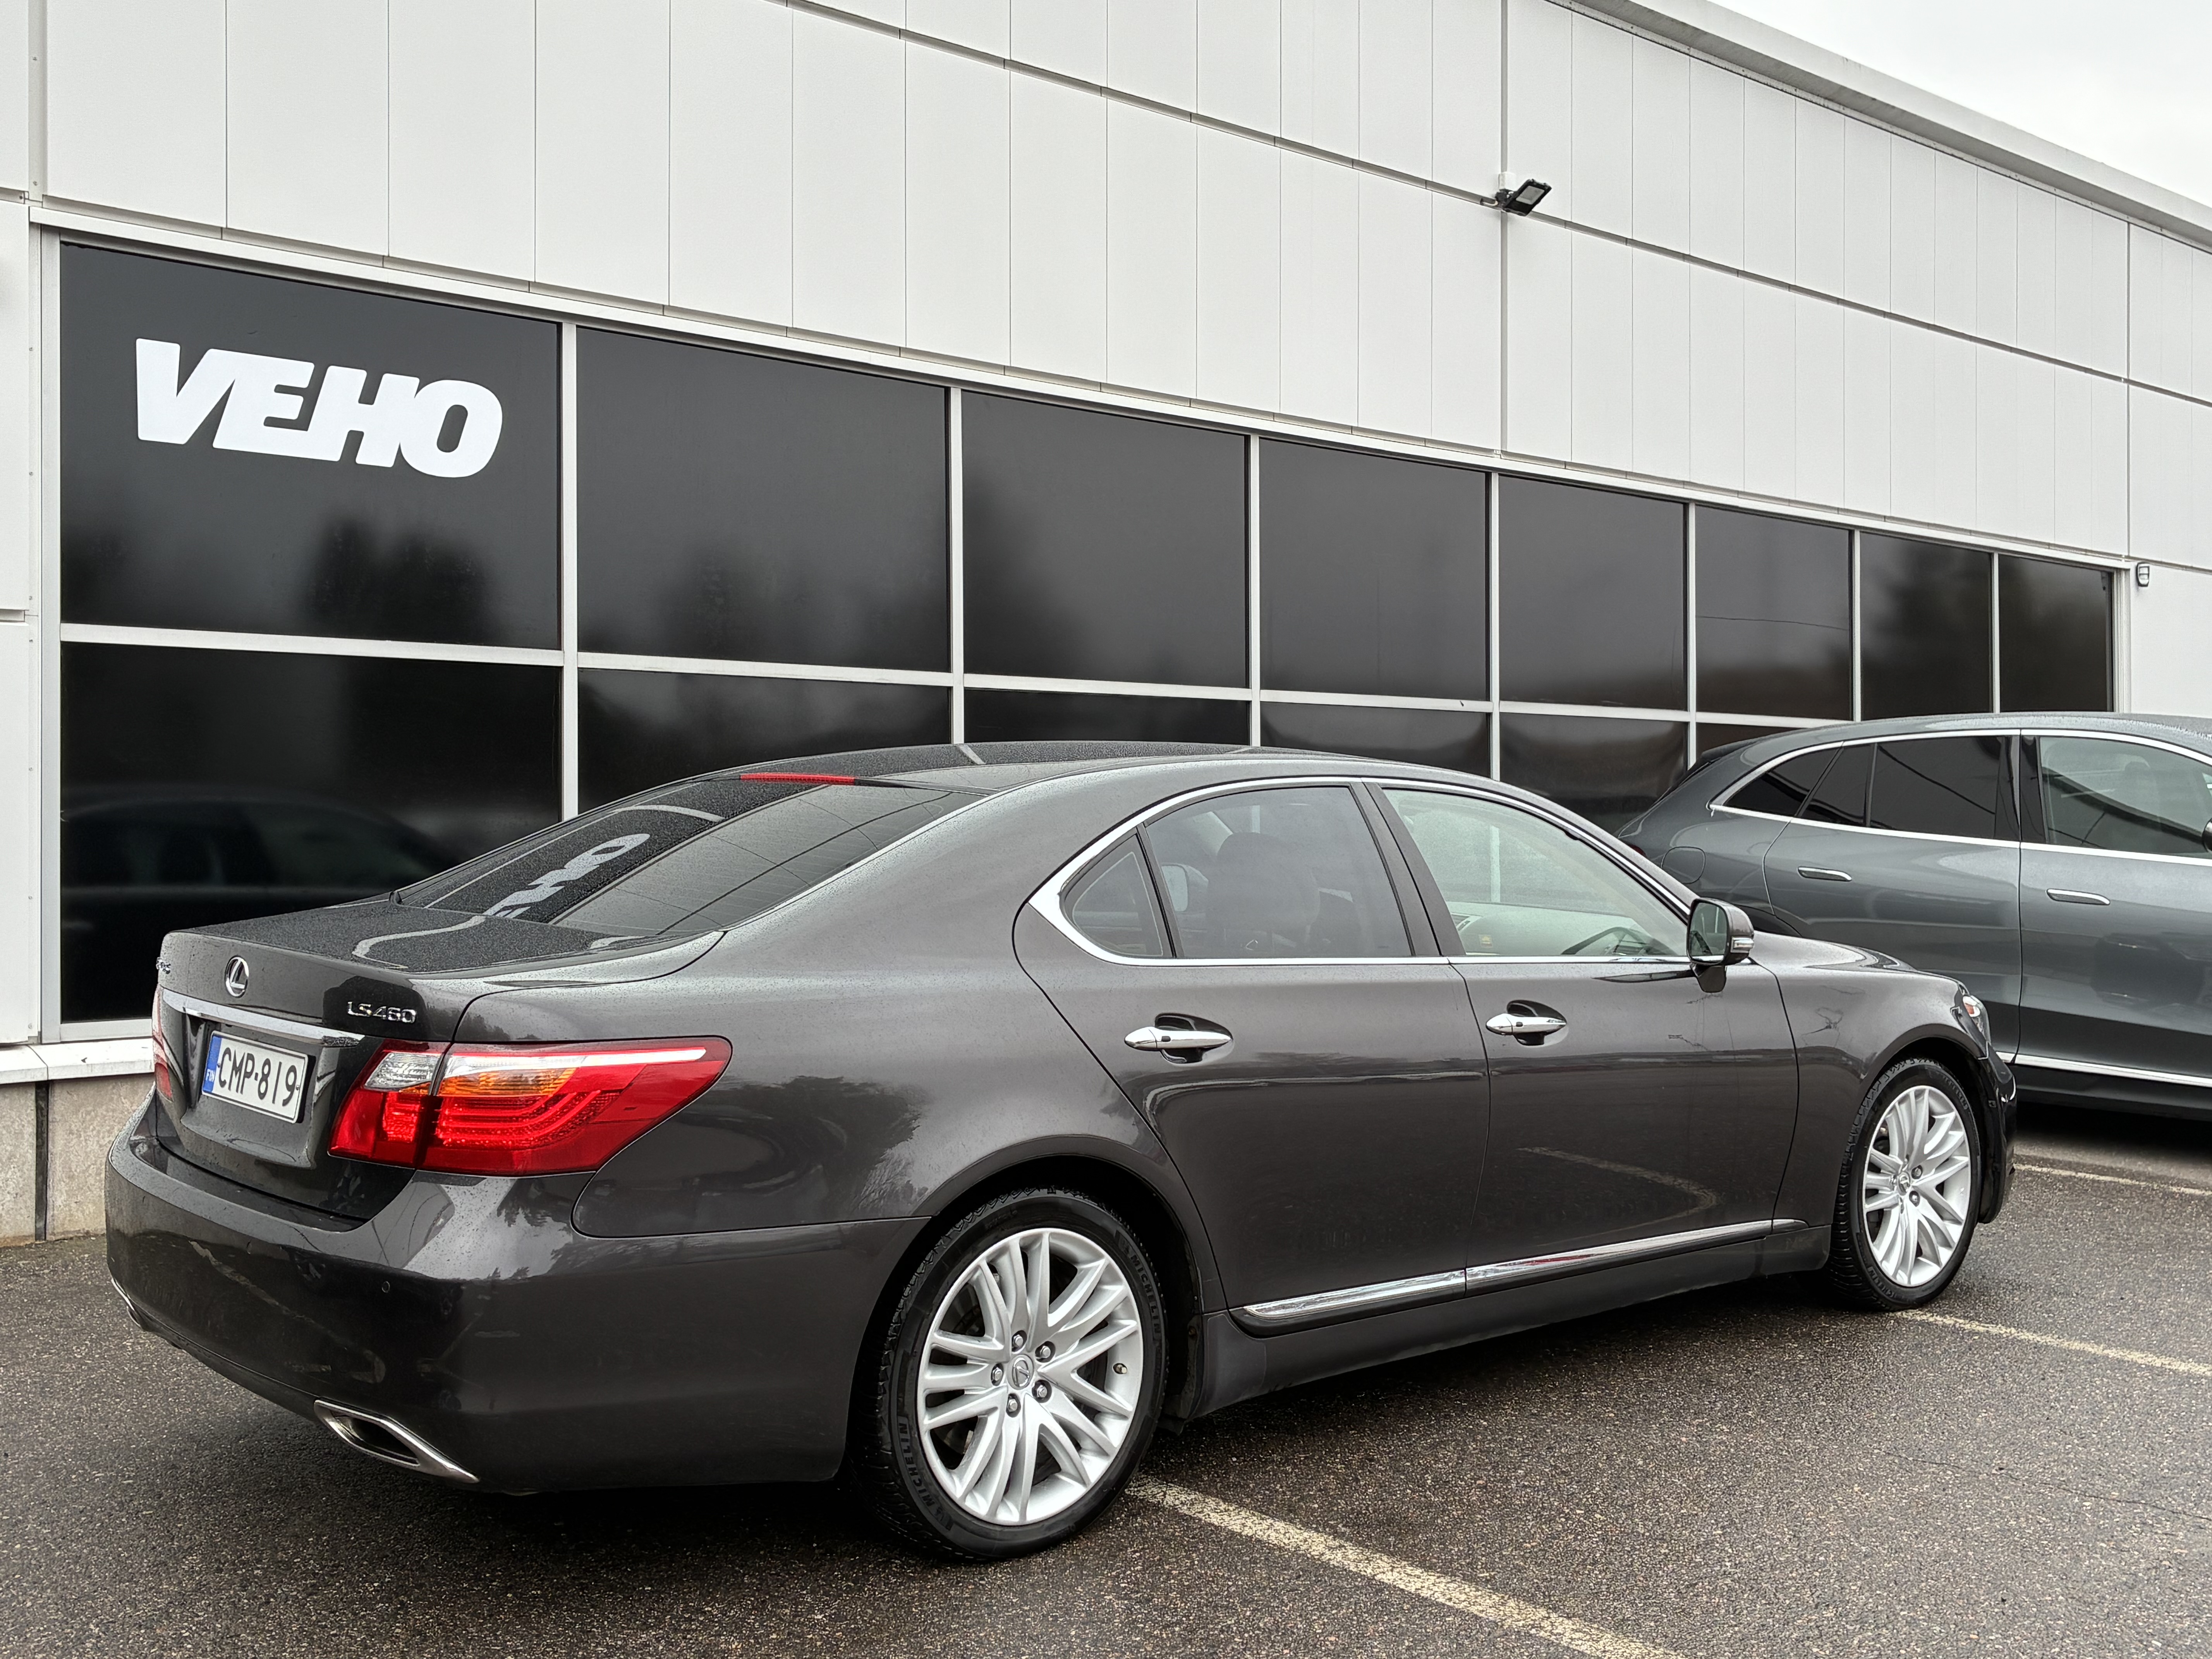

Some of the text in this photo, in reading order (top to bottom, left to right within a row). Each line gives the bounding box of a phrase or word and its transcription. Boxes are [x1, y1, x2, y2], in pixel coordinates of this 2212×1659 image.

[136, 338, 503, 478] VEHO
[219, 1047, 297, 1107] CMP-819
[1130, 1254, 1161, 1333] MICHELIN
[898, 1422, 935, 1507] MICHELIN
